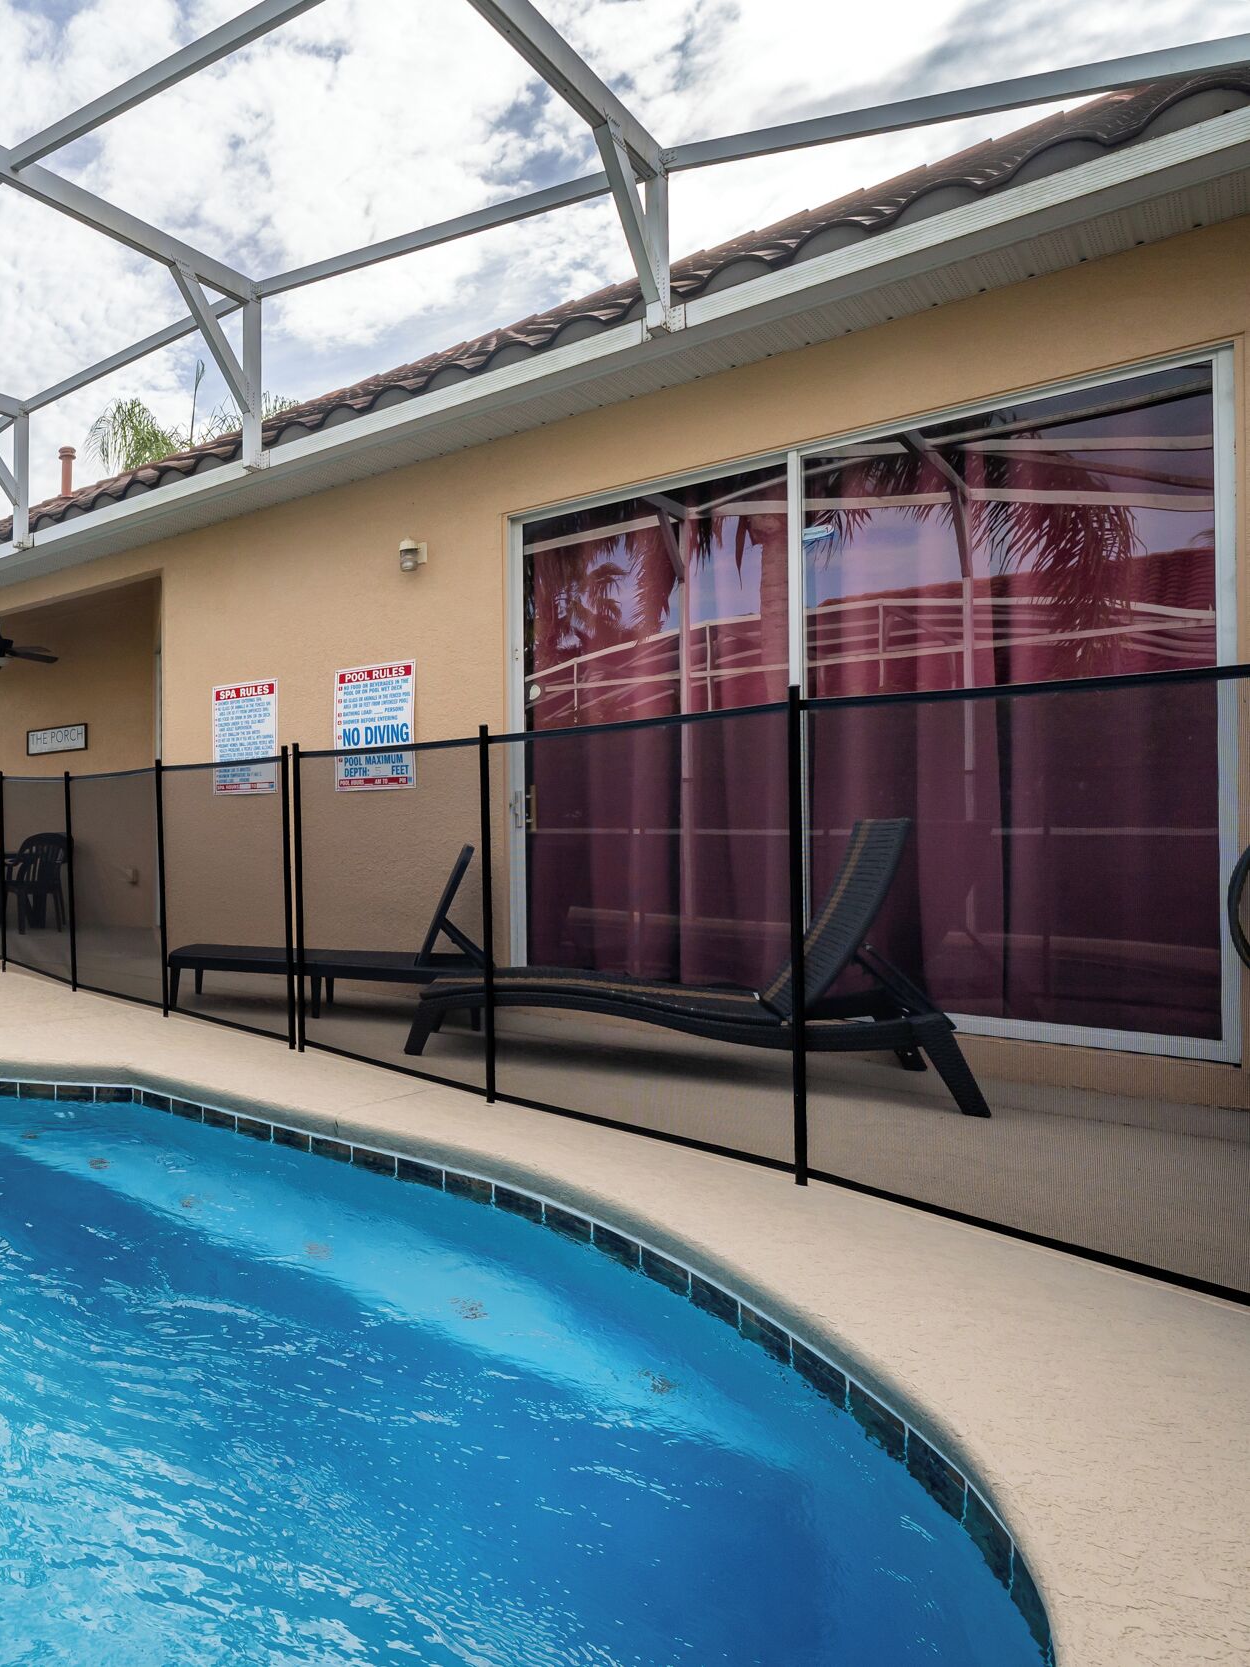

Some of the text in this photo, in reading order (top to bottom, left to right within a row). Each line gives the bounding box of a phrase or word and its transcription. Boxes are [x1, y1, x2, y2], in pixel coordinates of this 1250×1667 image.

[345, 667, 405, 682] POOL RULES
[220, 685, 269, 699] SPA RULES
[30, 728, 83, 745] THE PORCH
[343, 728, 360, 746] NO
[364, 722, 409, 745] DIVING
[344, 757, 362, 766] POOL
[365, 754, 403, 765] MAXIMUM
[344, 767, 370, 777] DEPTH:
[392, 765, 409, 775] FEET
